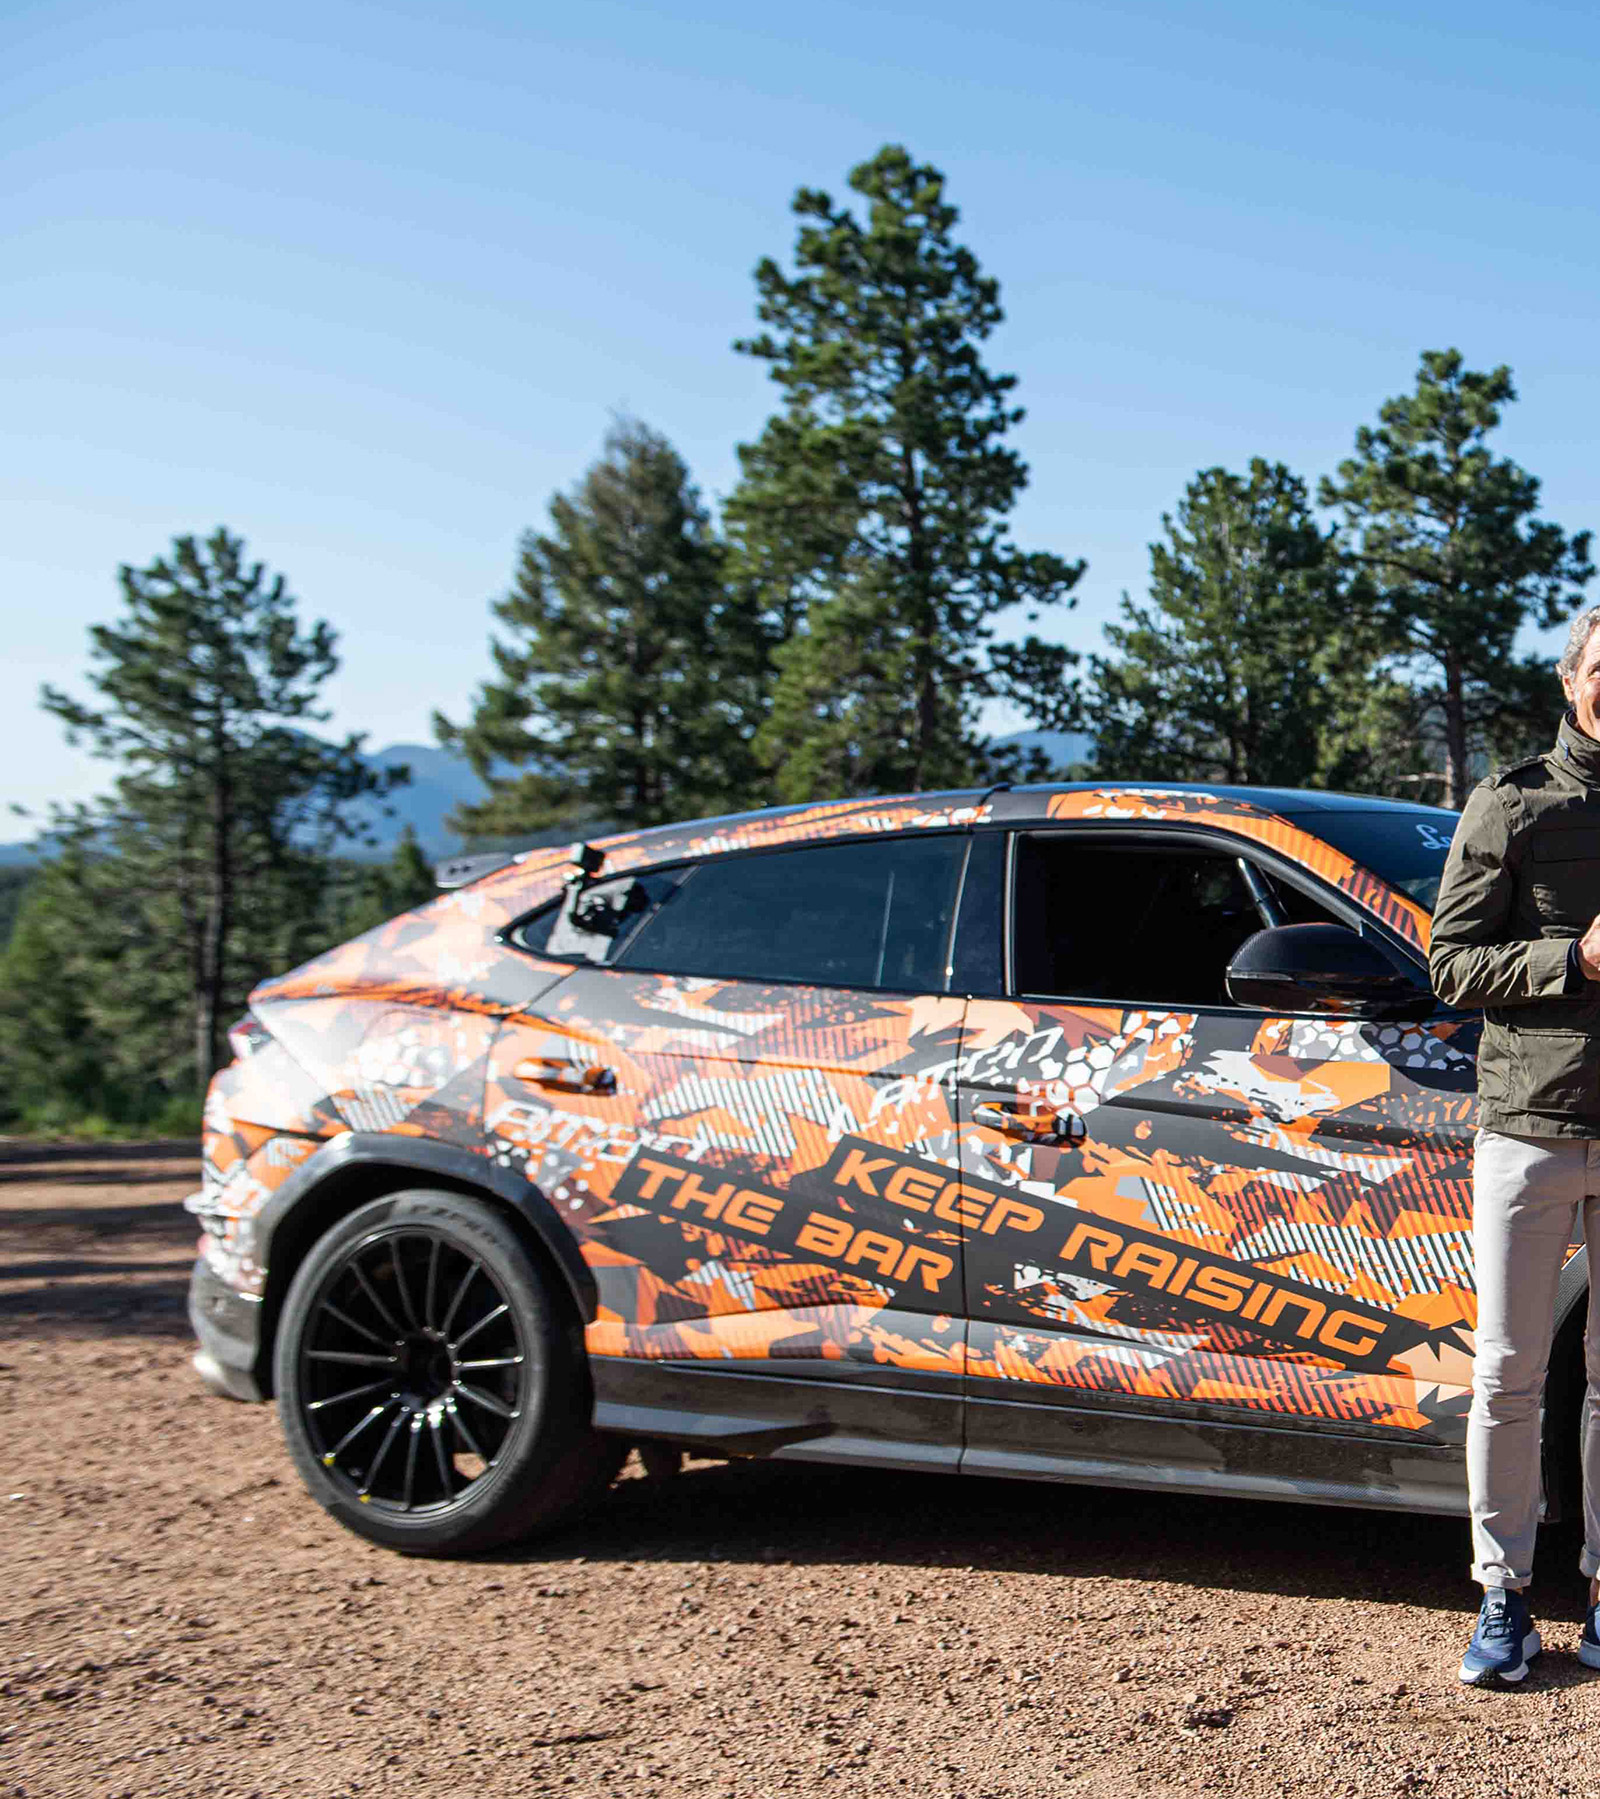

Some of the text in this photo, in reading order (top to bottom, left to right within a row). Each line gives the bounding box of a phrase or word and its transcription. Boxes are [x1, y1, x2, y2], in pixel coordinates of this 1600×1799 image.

[637, 1157, 954, 1293] THE BAR
[833, 1148, 1388, 1356] KEEP RAISING
